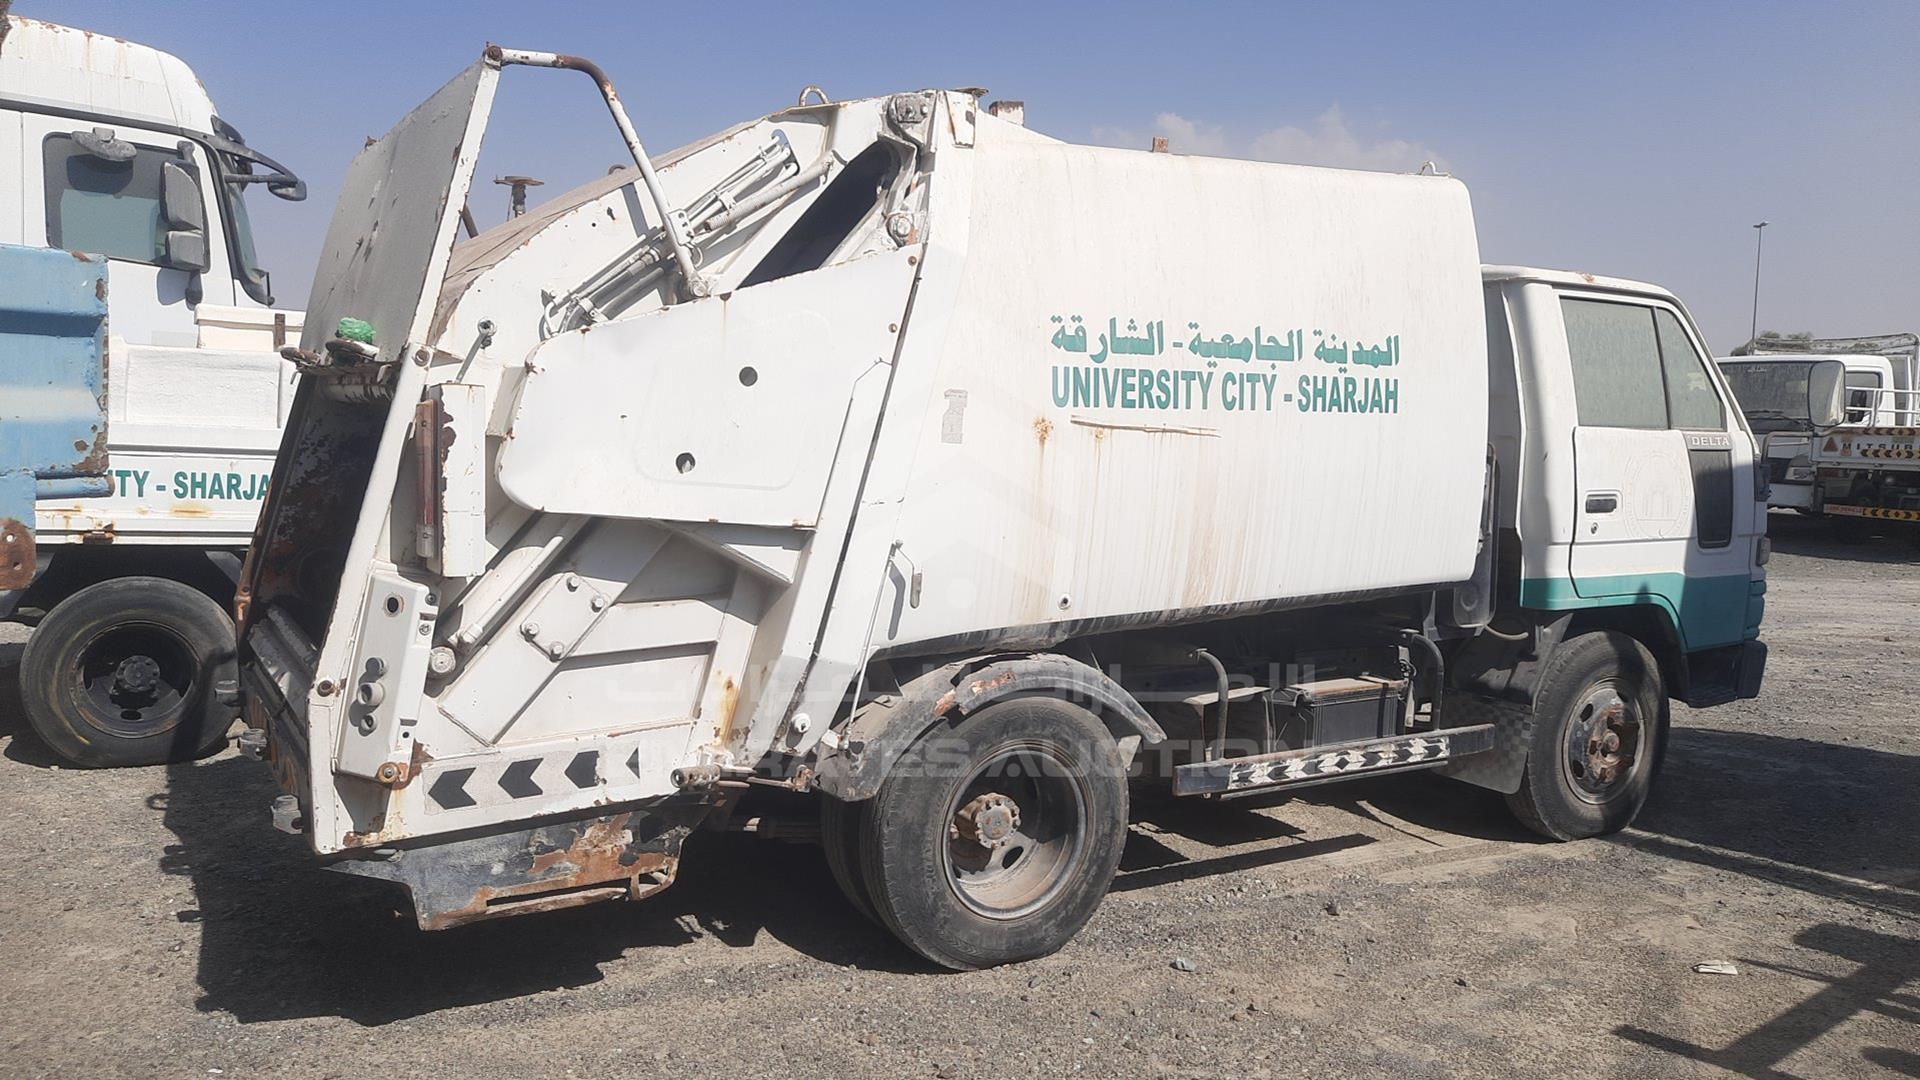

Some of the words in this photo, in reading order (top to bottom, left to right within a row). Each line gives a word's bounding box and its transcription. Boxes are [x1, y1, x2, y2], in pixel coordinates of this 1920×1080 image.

[1050, 314, 1164, 364] الشارقة
[1187, 321, 1303, 369] الجامعية
[1312, 328, 1400, 374] المدينة
[1051, 365, 1214, 410] UNIVERSITY
[1221, 370, 1277, 412] CITY
[1298, 374, 1399, 414] SHARJAH
[1691, 436, 1730, 446] DELTA
[1842, 442, 1920, 450] MITSUB
